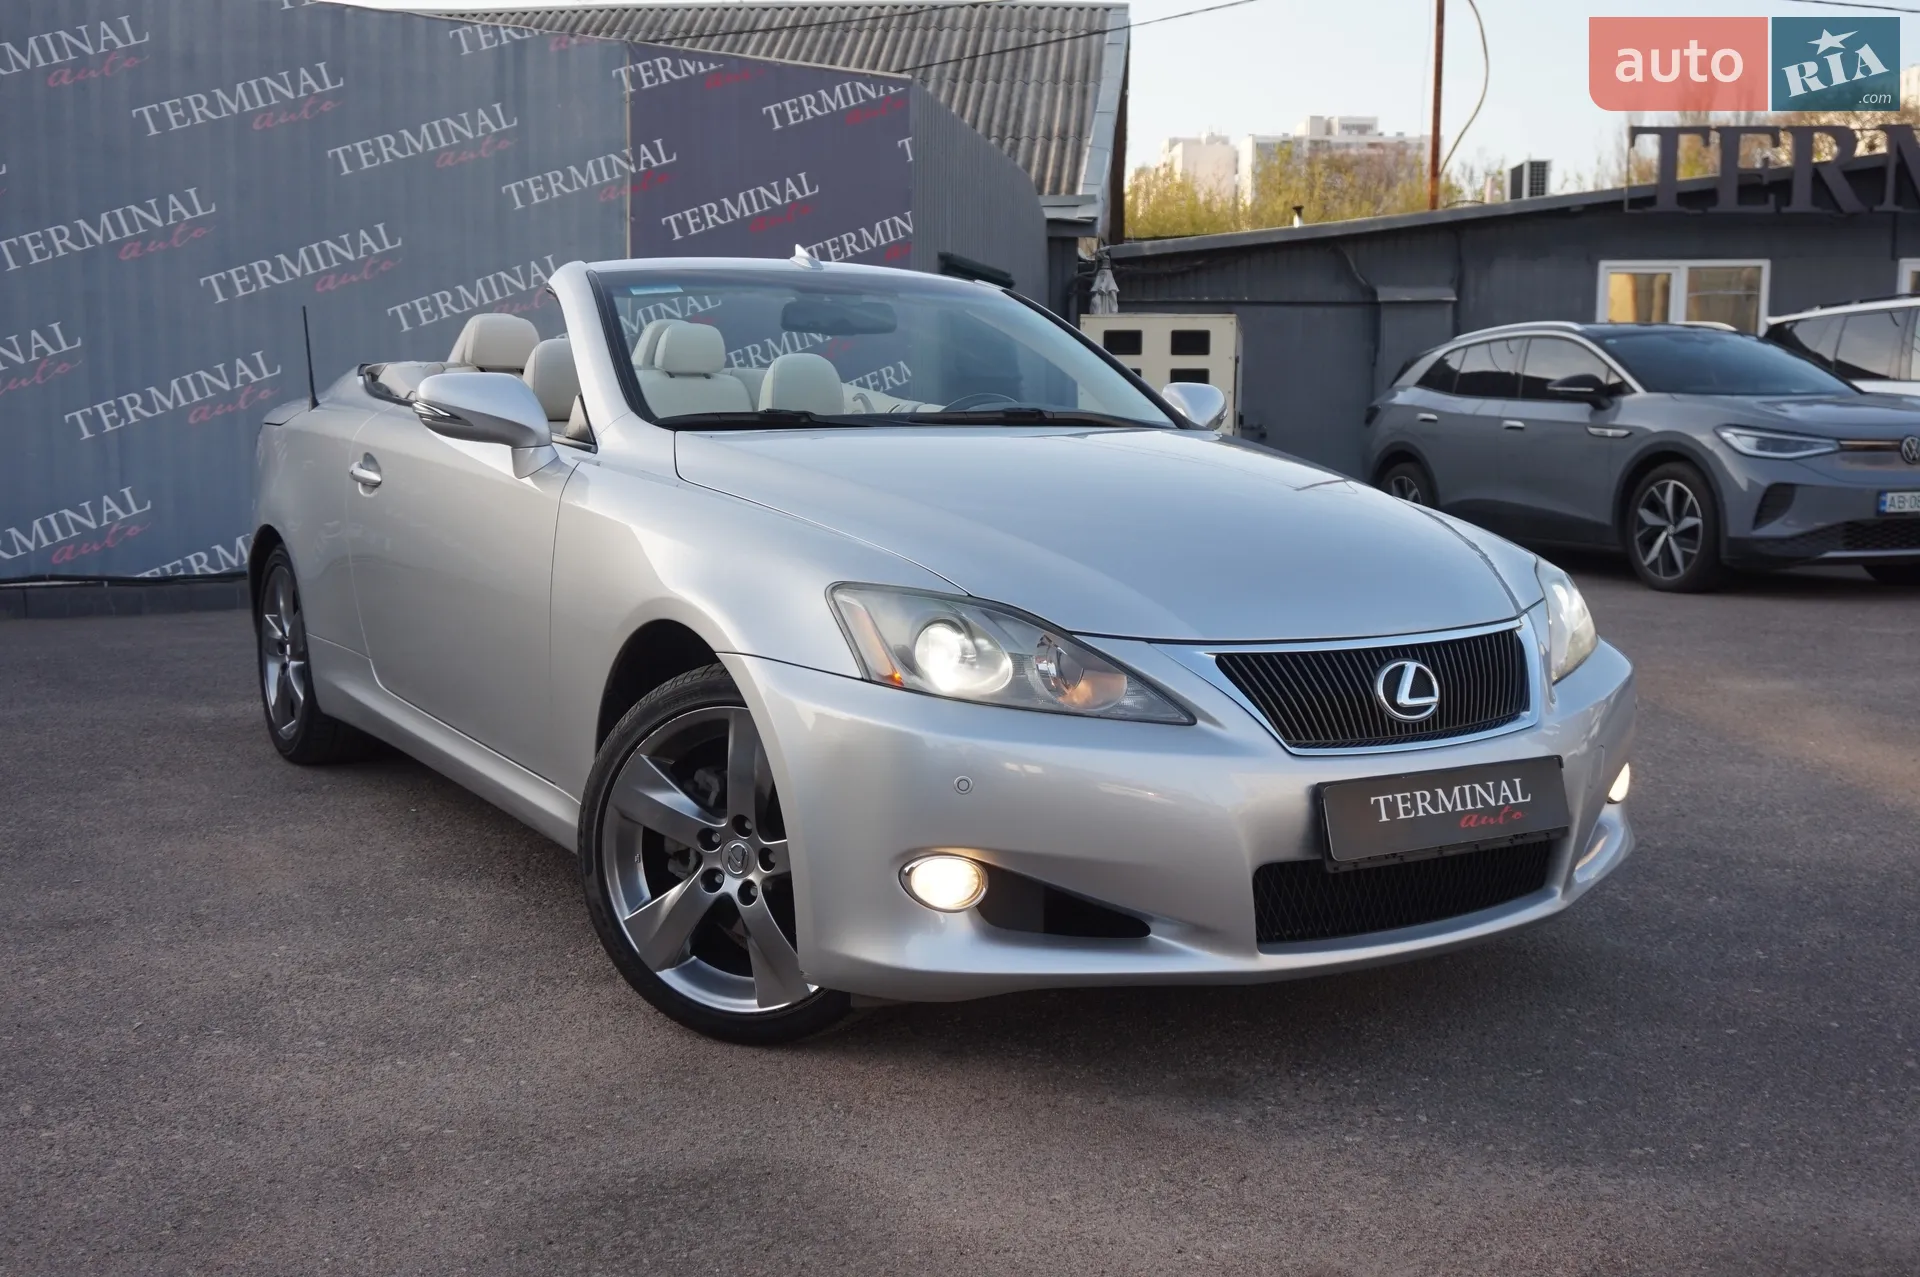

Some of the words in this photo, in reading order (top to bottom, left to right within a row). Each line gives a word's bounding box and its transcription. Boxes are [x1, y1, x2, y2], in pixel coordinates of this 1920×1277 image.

[0, 15, 149, 75] MINAL
[47, 52, 149, 87] auto
[132, 62, 344, 136] TERMINAL
[252, 97, 342, 131] auto
[327, 102, 517, 176] TERMINAL
[435, 136, 518, 168] auto
[502, 138, 678, 210] TERMINAL
[0, 187, 216, 271] TERMINAL
[661, 172, 819, 241] TERMINAL
[118, 224, 217, 261] auto
[199, 223, 402, 304] TERMINAL
[315, 257, 403, 293] auto
[65, 350, 281, 440] TERMINAL
[187, 386, 280, 424] auto
[51, 522, 151, 565] auto
[1371, 778, 1531, 823] TERMINAL
[1459, 805, 1530, 829] auto
